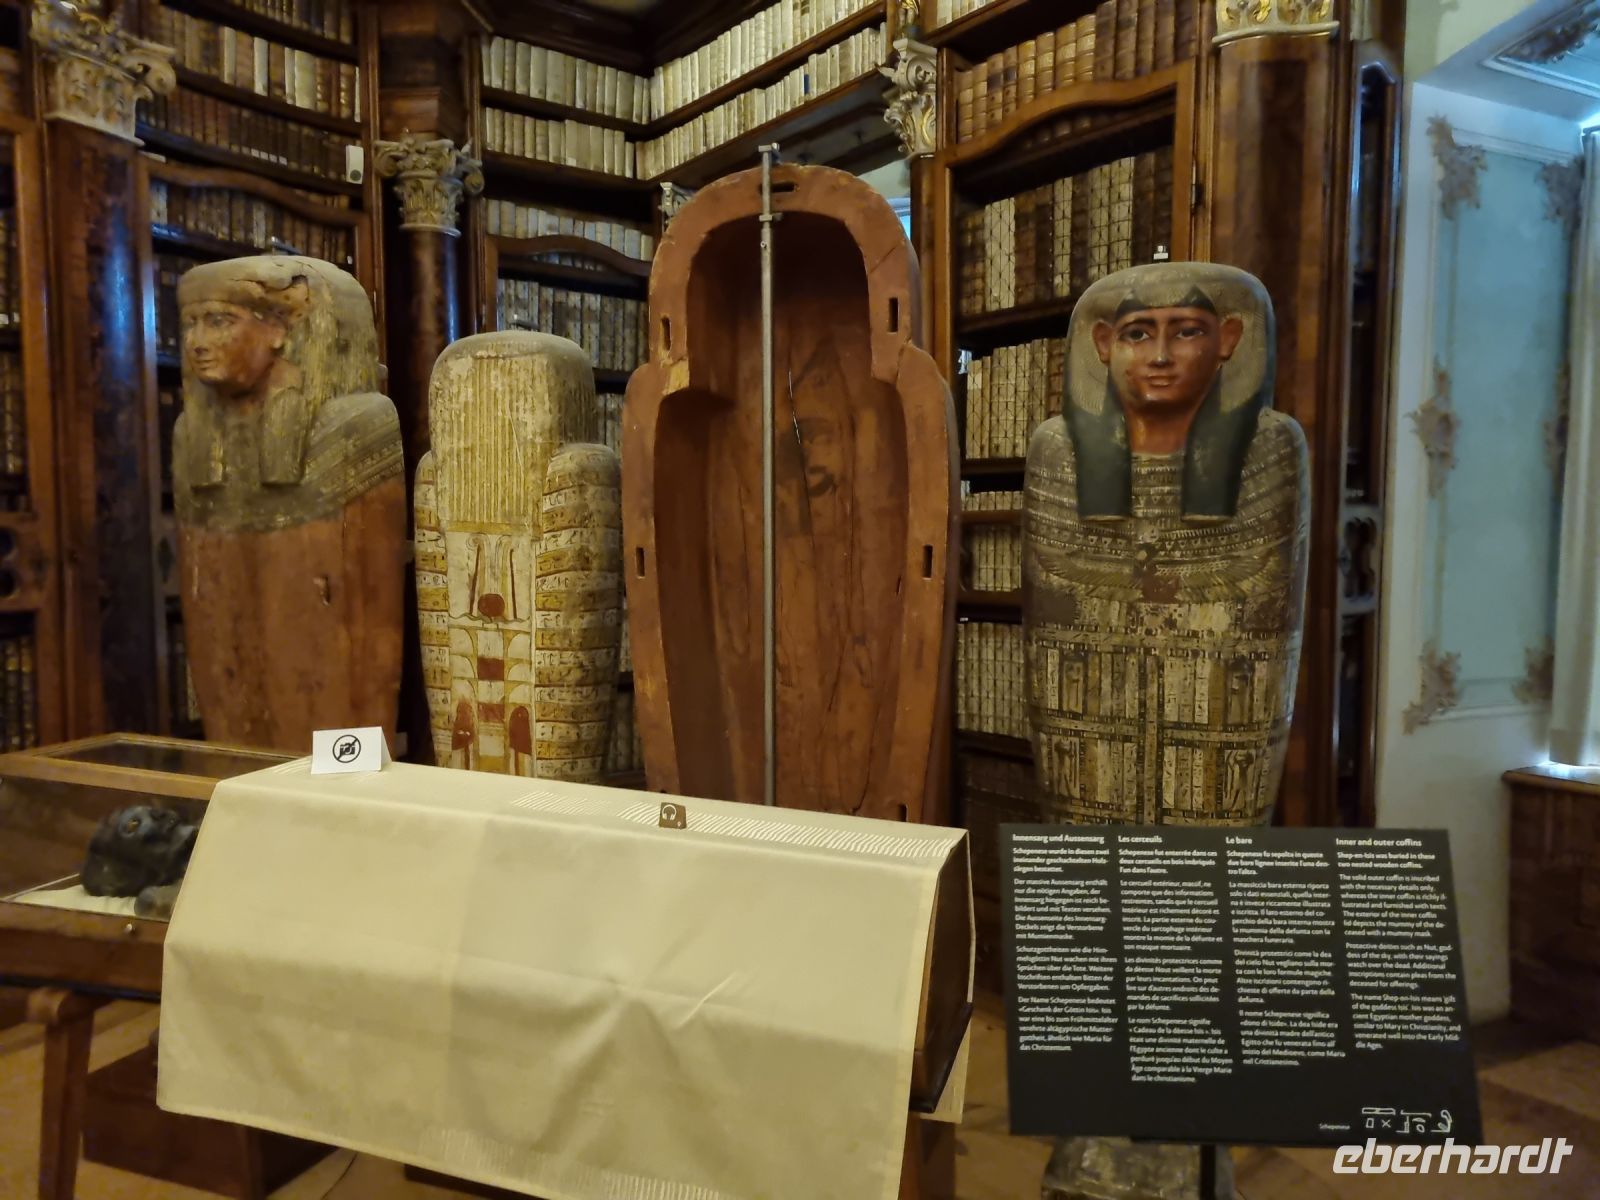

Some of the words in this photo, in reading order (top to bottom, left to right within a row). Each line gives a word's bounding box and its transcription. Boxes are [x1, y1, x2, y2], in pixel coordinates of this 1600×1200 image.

[1049, 834, 1064, 843] und
[1118, 835, 1130, 843] Les
[1225, 836, 1235, 844] Le
[1235, 836, 1253, 844] bare
[1336, 837, 1356, 846] Inner
[1358, 838, 1373, 846] and
[1373, 838, 1394, 846] outer
[1396, 838, 1422, 847] coffins
